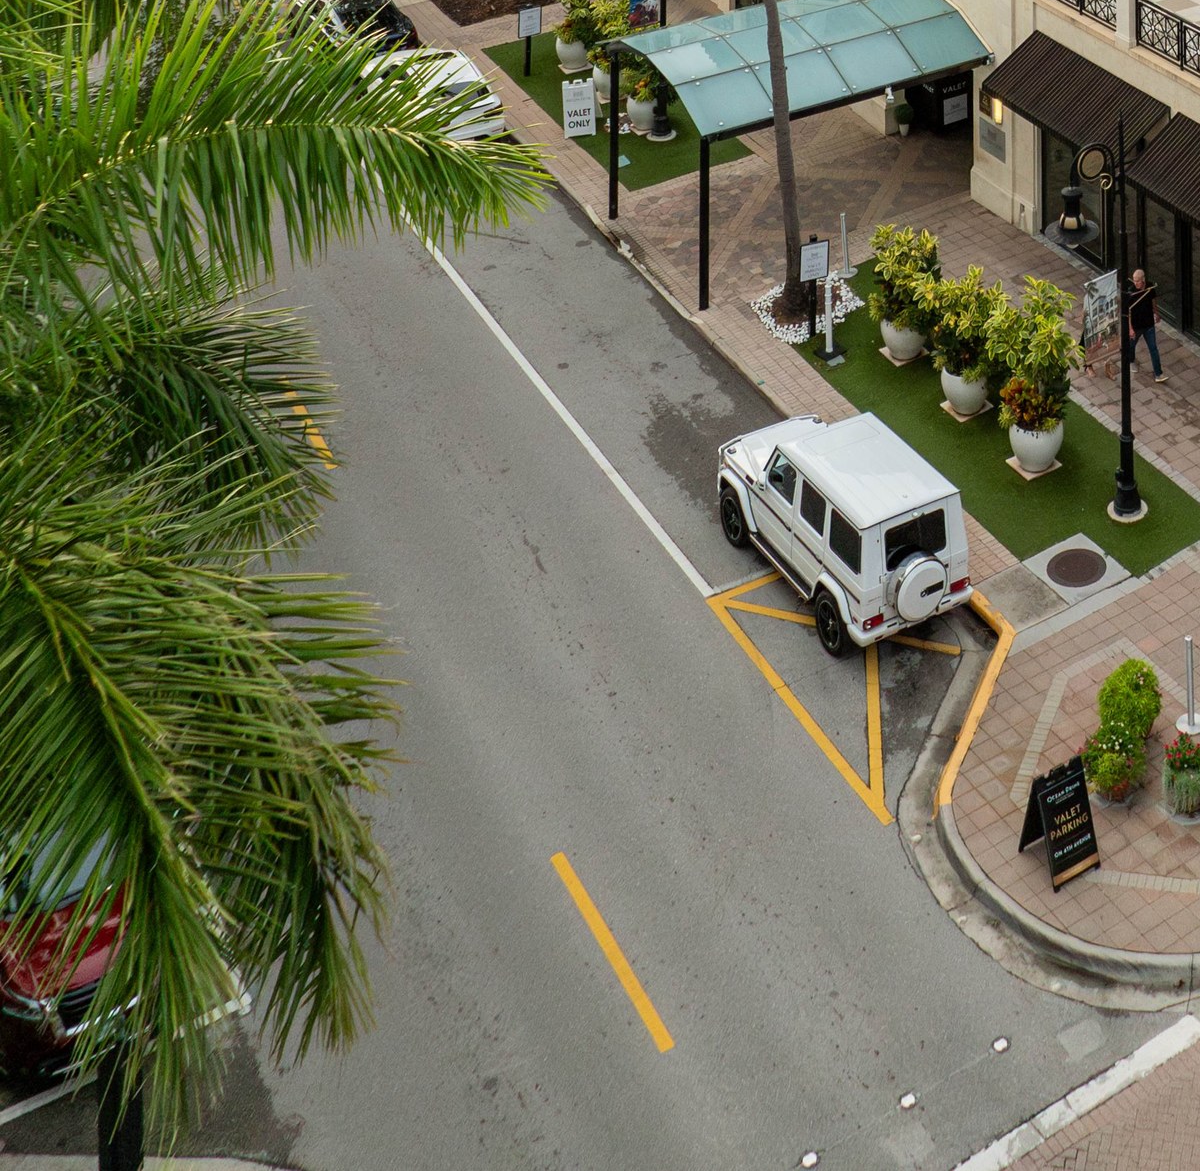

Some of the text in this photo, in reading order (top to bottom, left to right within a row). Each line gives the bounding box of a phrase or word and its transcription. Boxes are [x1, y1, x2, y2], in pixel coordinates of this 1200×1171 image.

[567, 108, 591, 118] VALET
[568, 119, 590, 129] ONLY
[1054, 803, 1081, 825] VALET
[1050, 812, 1088, 840] PARKING
